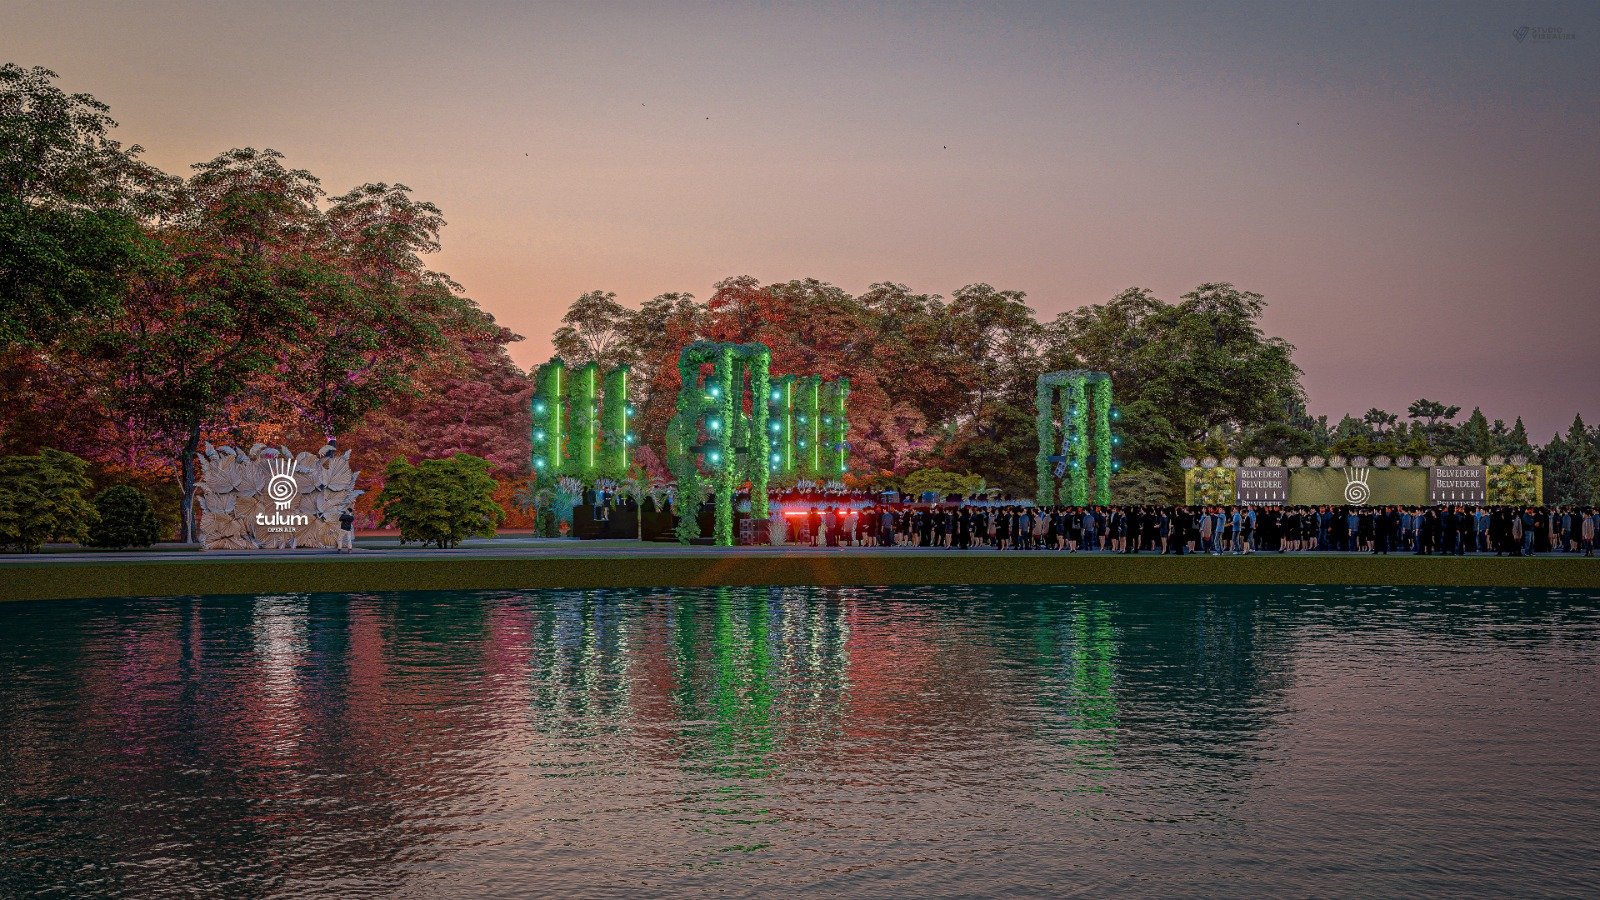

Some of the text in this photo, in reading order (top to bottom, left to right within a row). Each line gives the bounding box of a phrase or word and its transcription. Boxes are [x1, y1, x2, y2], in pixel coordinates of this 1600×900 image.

[1241, 470, 1283, 478] BELVEDERE
[1436, 469, 1481, 478] BELVEDERE
[1241, 480, 1283, 488] BELVEDERE
[1436, 479, 1481, 488] BELVEDERE
[255, 511, 309, 526] tulum
